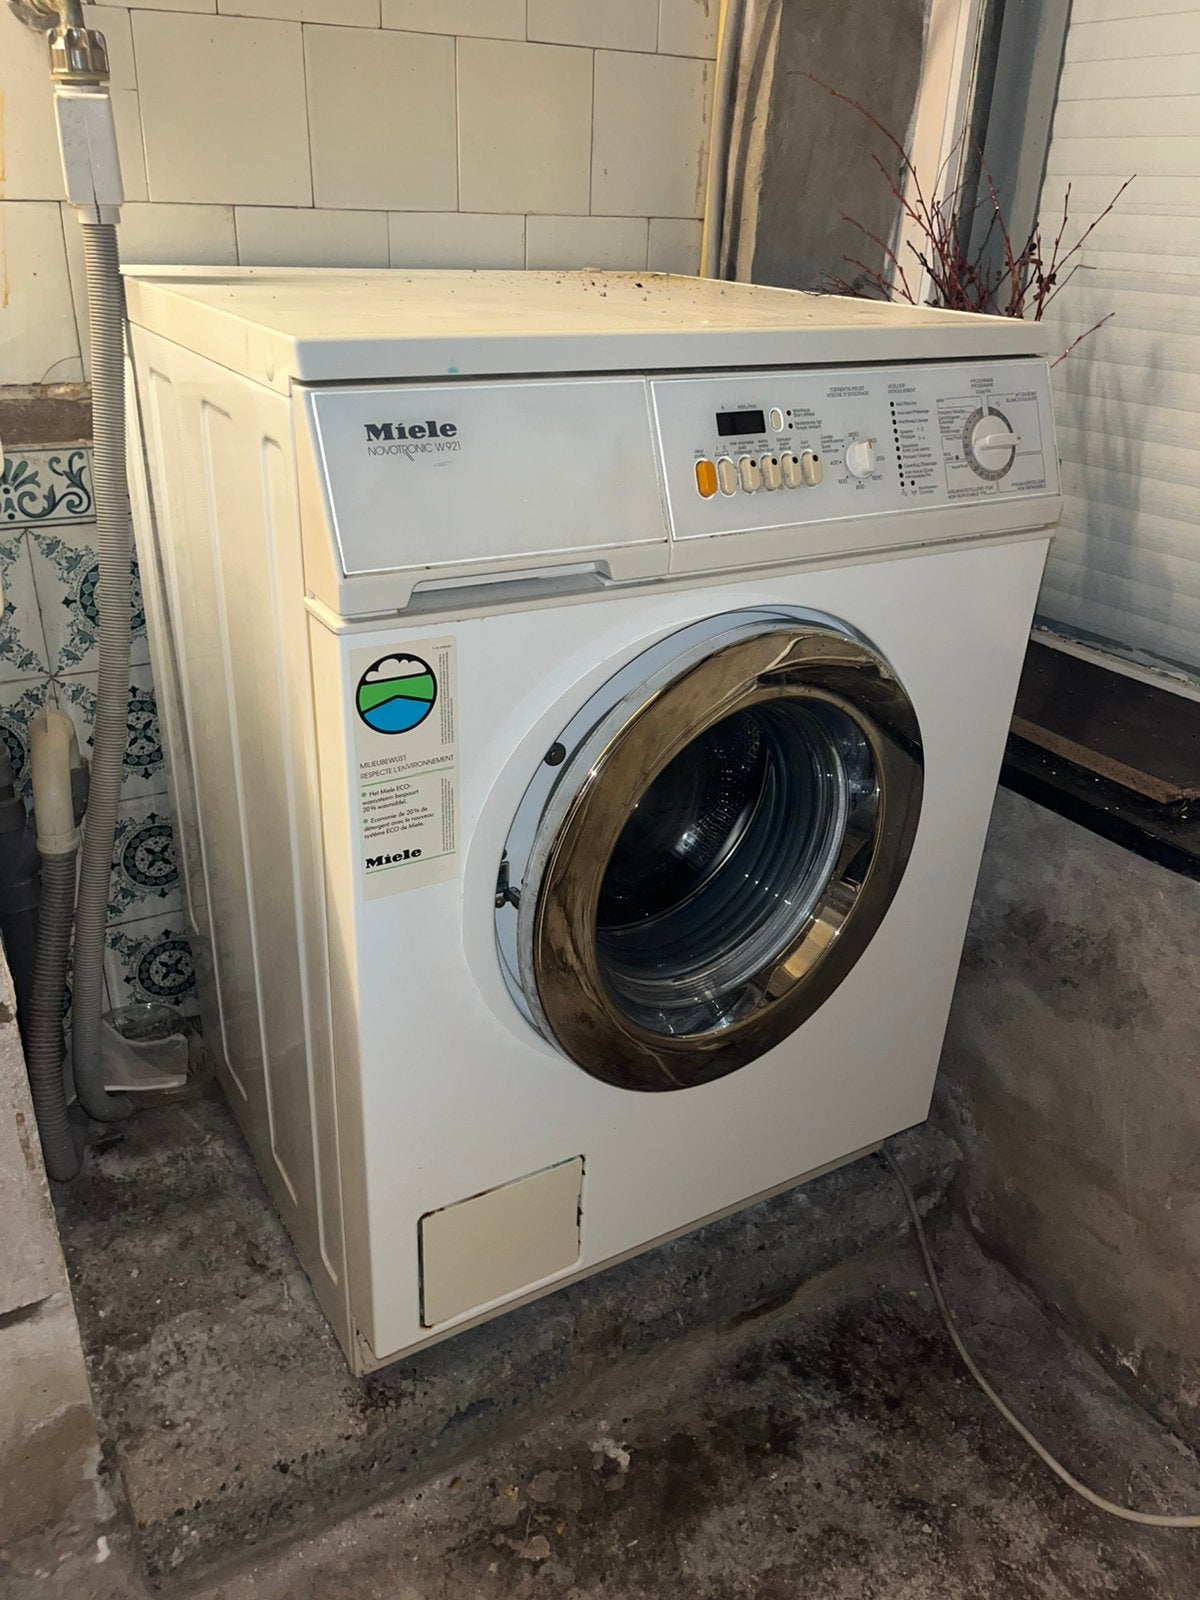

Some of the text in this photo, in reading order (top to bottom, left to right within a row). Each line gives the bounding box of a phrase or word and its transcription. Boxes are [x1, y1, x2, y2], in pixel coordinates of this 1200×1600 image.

[364, 420, 457, 442] Miele
[367, 443, 433, 456] NOVOTRONIC
[365, 848, 422, 869] Miele
